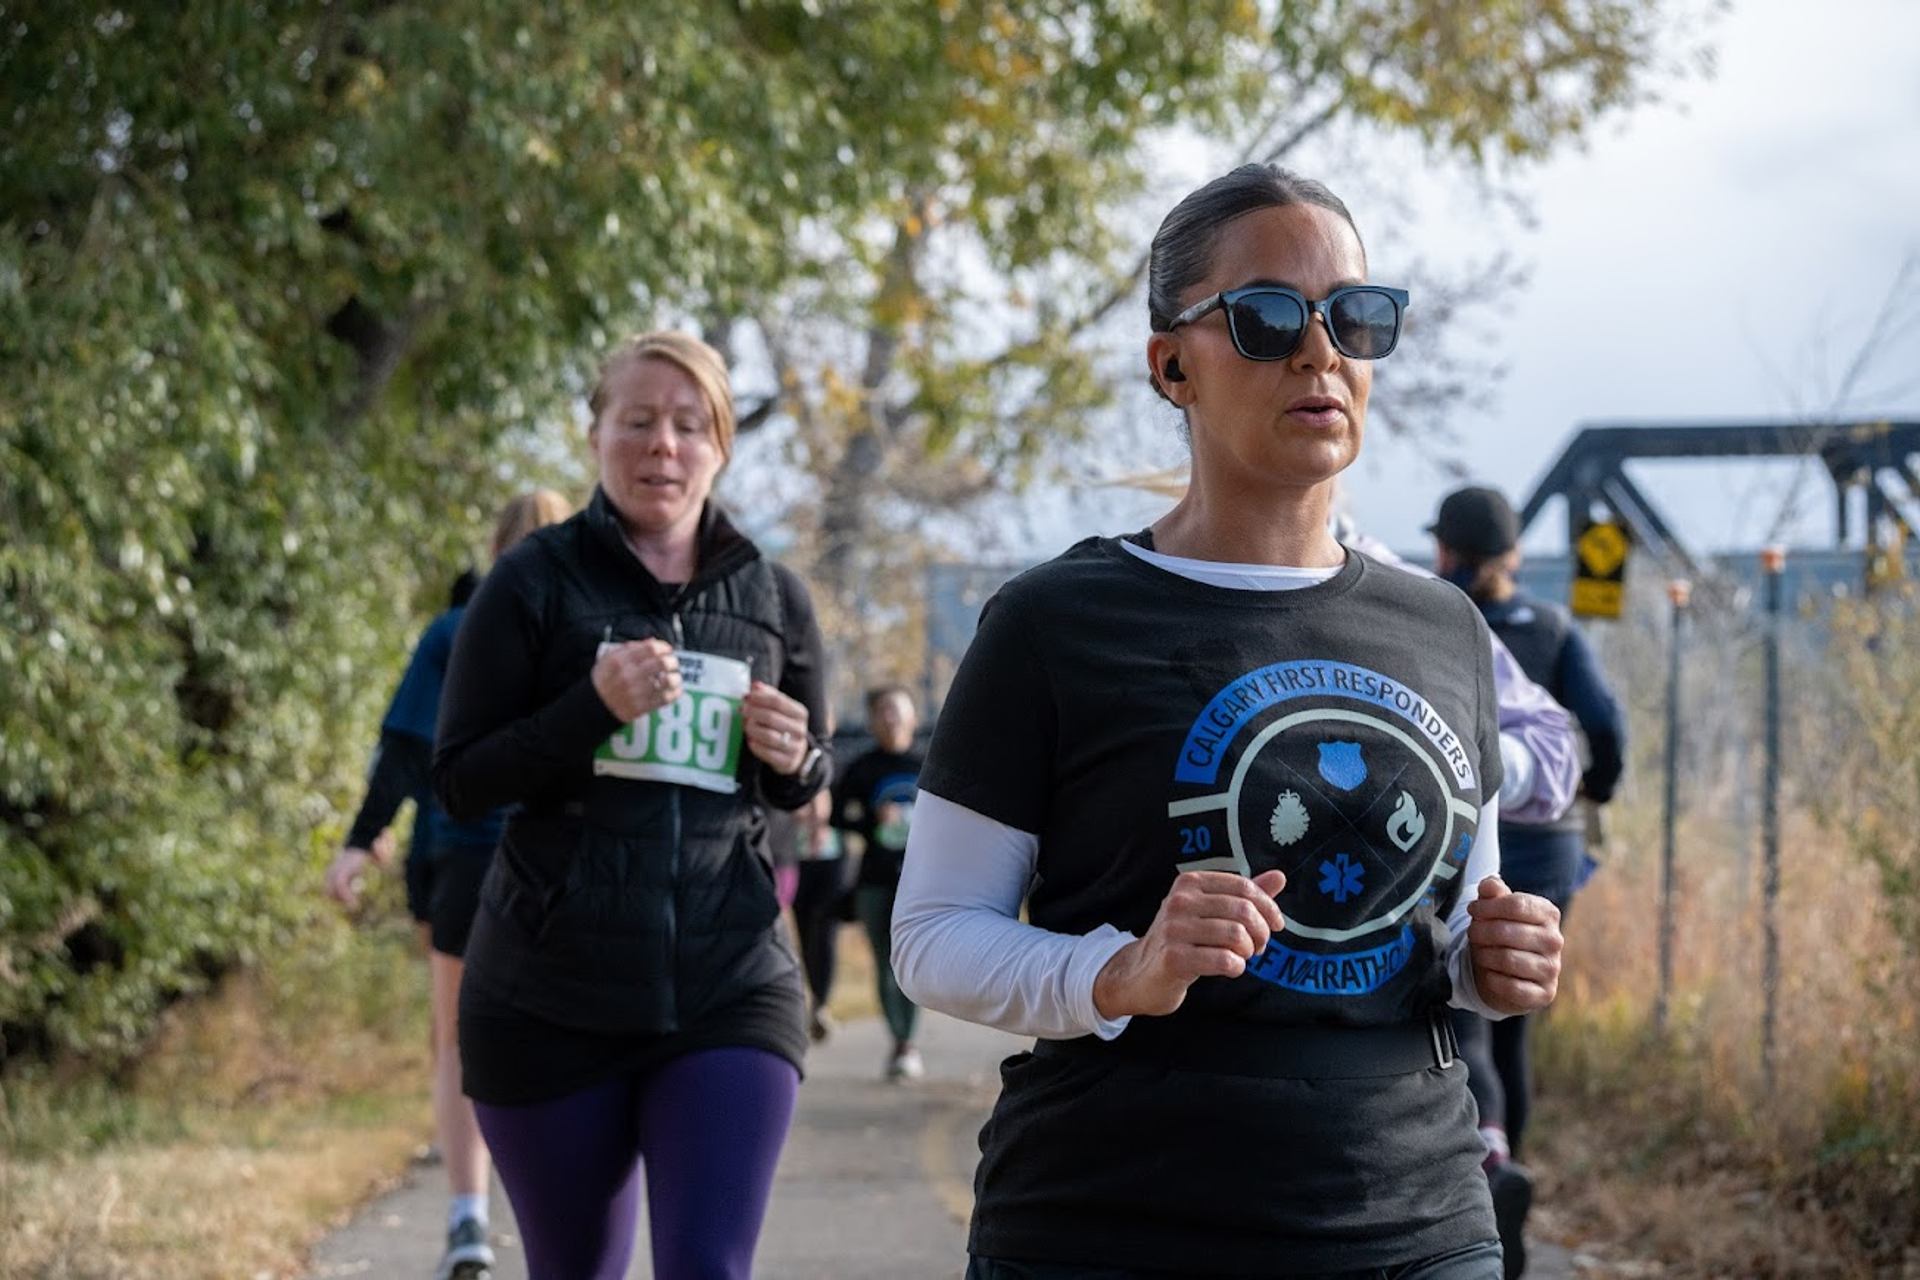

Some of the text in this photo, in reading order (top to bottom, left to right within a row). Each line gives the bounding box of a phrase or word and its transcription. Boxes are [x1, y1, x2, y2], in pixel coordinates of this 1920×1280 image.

[1187, 667, 1471, 779] CALGARY FIRST RESPONDERS
[1179, 825, 1211, 854] 20
